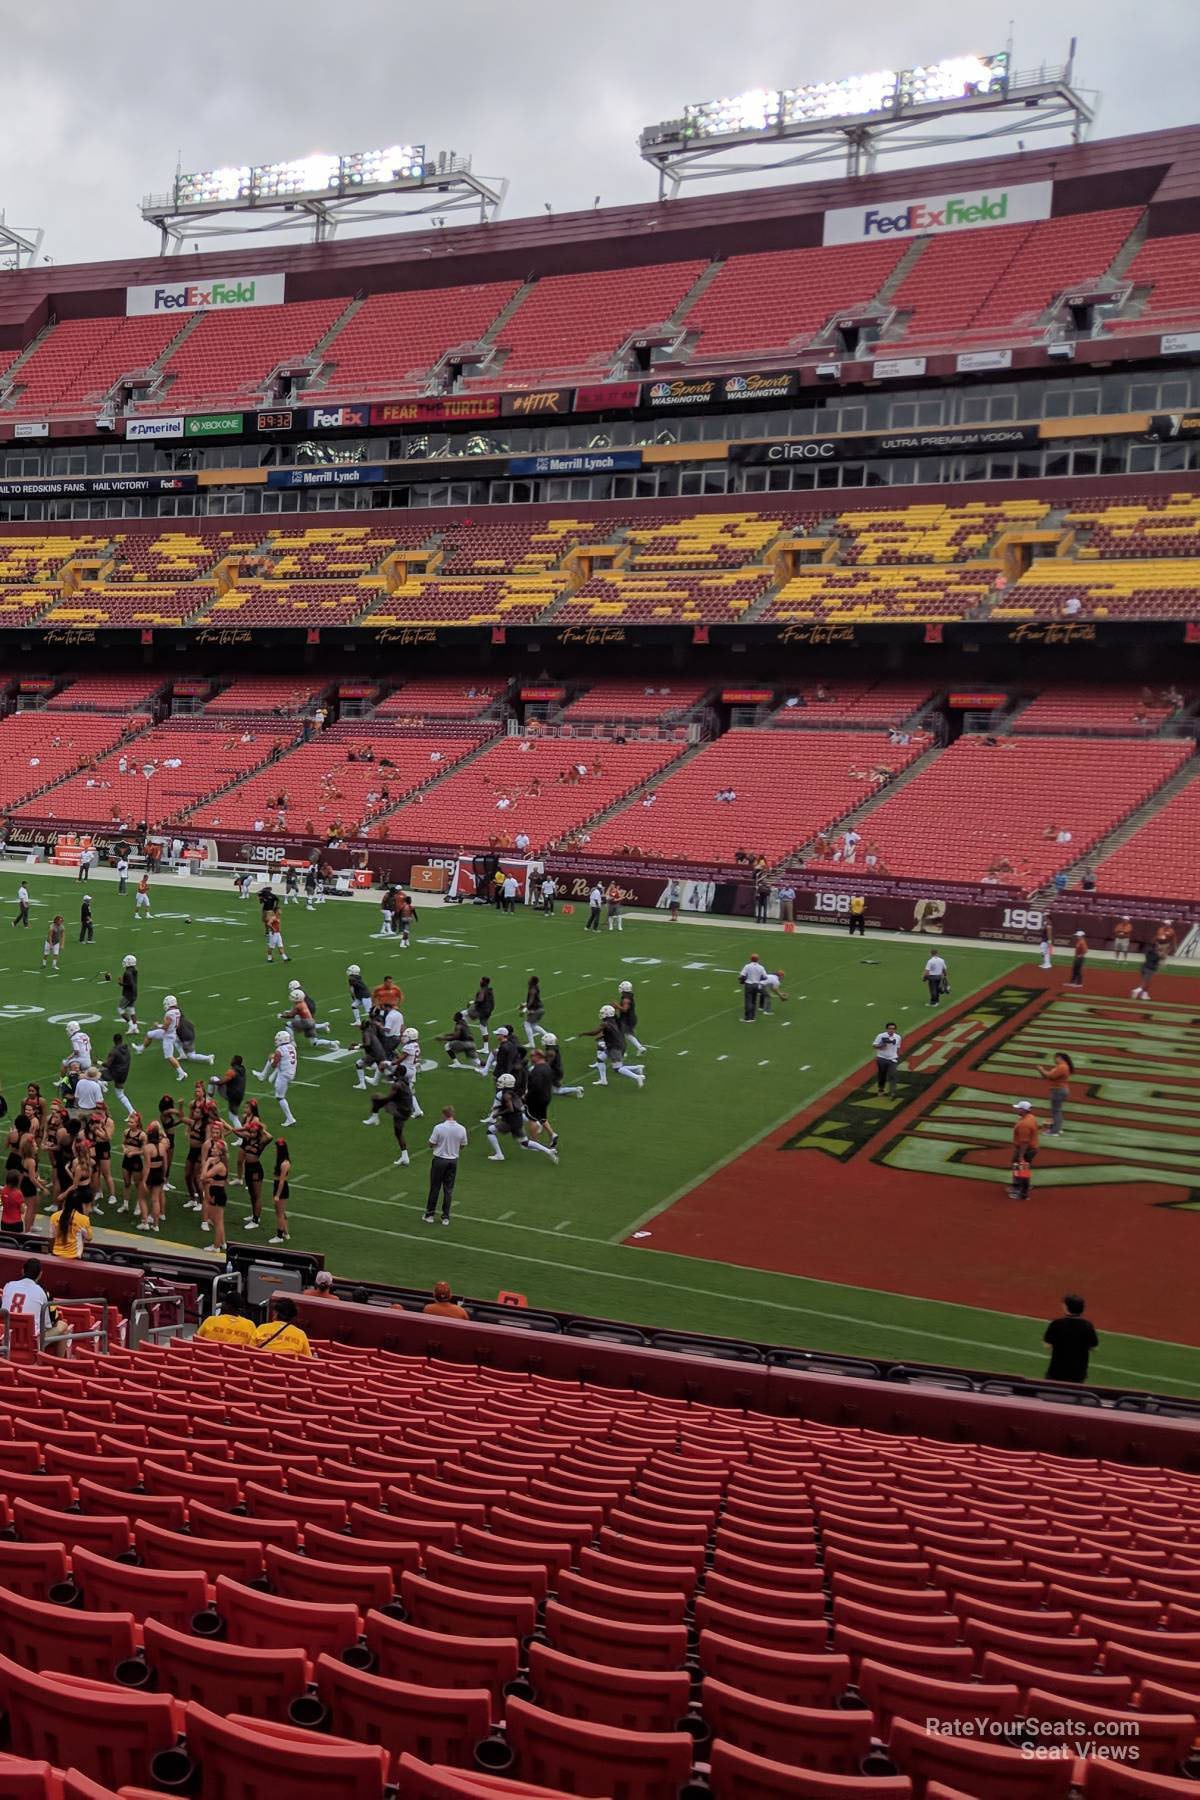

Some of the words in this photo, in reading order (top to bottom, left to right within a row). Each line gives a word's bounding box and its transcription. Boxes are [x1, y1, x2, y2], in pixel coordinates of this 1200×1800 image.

[864, 193, 1007, 235] FedExField
[154, 281, 255, 309] FedExField
[670, 381, 714, 397] Sports
[745, 375, 792, 391] Sports
[652, 394, 711, 406] WASHINGTON
[727, 387, 788, 400] WASHINGTON
[200, 420, 221, 430] XBOX
[222, 419, 239, 428] ONE
[313, 408, 362, 427] FedEx
[137, 422, 181, 434] Ameritel
[882, 437, 919, 448] ULTRA
[920, 434, 978, 446] PREMIUM
[980, 431, 1024, 442] VODKA
[768, 443, 835, 459] CÎROC
[550, 458, 582, 470] Merrill
[585, 457, 615, 469] Lynch
[160, 480, 183, 488] FedEx
[303, 471, 332, 483] Merrill
[334, 470, 360, 482] Lynch
[11, 485, 21, 493] TO
[22, 484, 61, 493] REDSKINS
[63, 483, 87, 491] FANS.
[93, 482, 111, 490] HAIL
[111, 481, 150, 490] VICTORY!
[10, 828, 34, 845] Hail
[35, 831, 46, 843] to
[47, 831, 58, 845] th
[251, 846, 286, 861] 1982
[814, 893, 850, 914] 198
[1002, 908, 1044, 931] 199
[9, 1292, 26, 1314] 8
